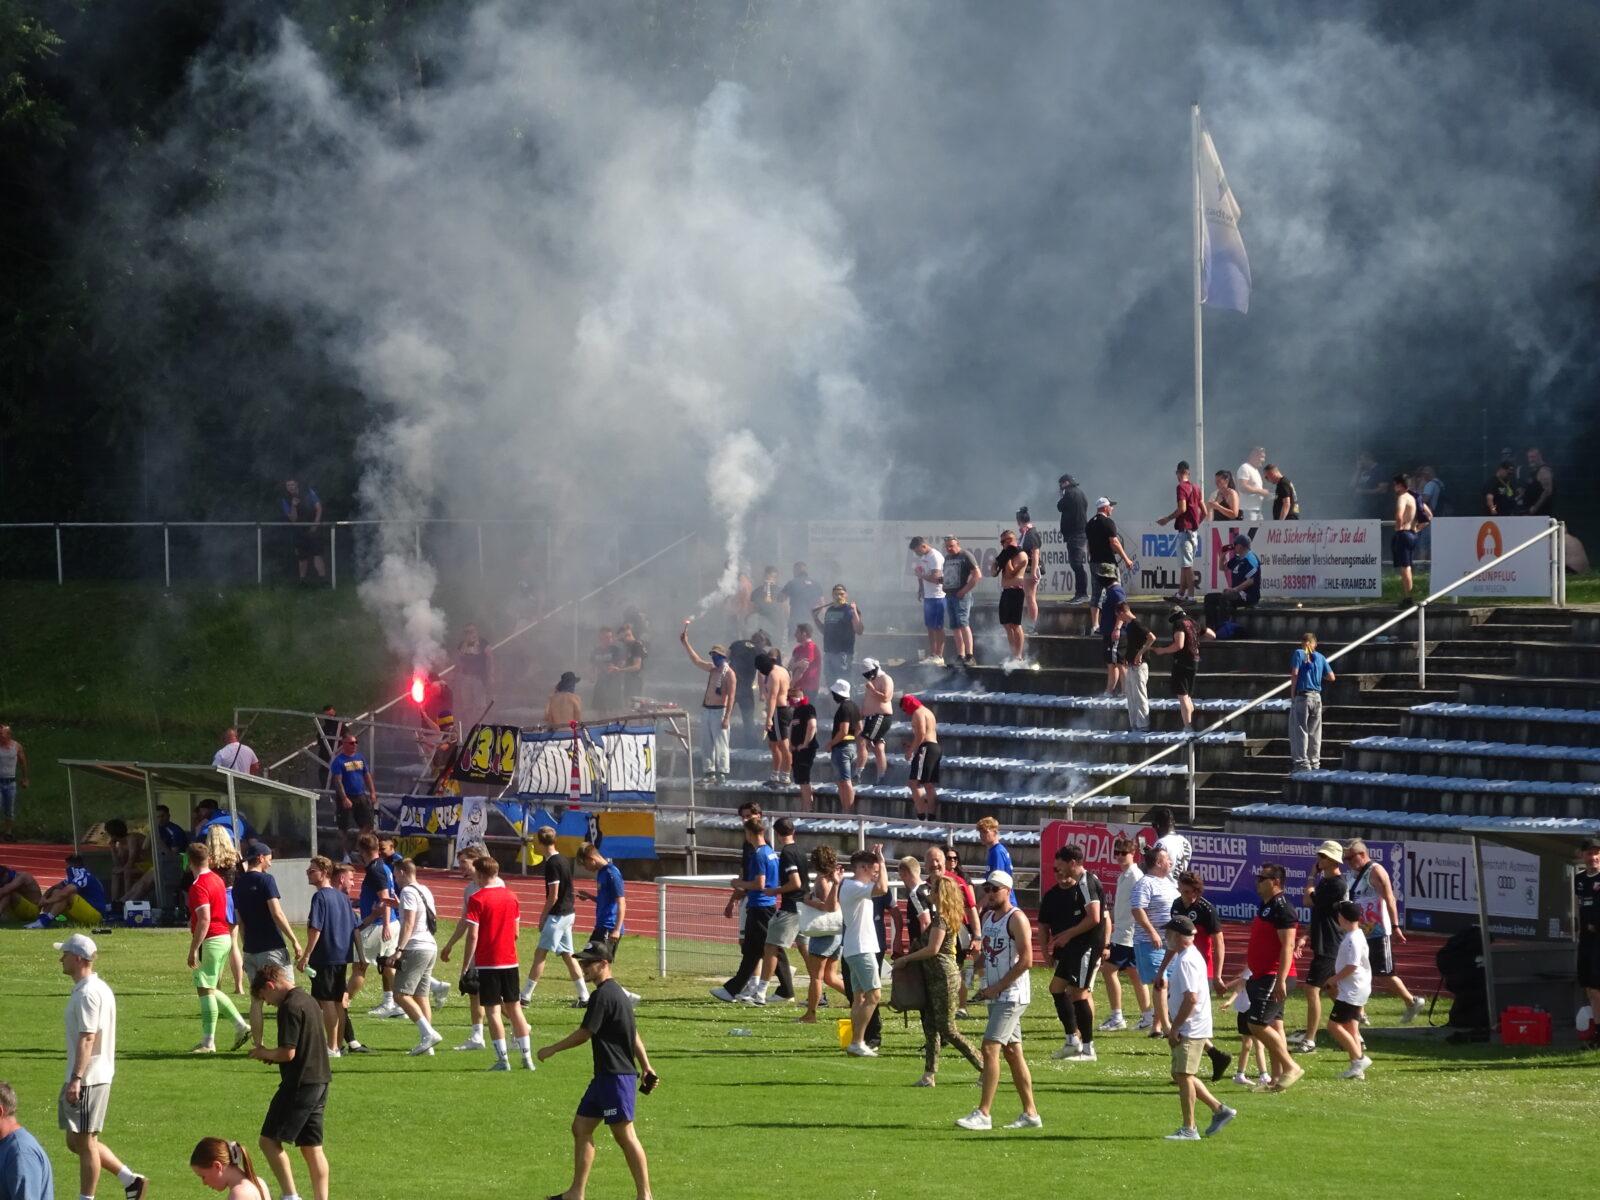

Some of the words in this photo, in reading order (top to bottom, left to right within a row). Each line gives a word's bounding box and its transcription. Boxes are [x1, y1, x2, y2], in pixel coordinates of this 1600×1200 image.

[1267, 528, 1281, 544] Mit
[1283, 526, 1323, 544] Sicherheit
[1322, 526, 1338, 549] für
[1339, 528, 1350, 544] Sie
[1352, 526, 1367, 544] da!
[1260, 555, 1270, 566] Die
[1272, 554, 1311, 566] Weißenfelser
[1313, 553, 1377, 568] Versicherungsmakler
[1141, 566, 1202, 589] MÜLLR
[1282, 574, 1316, 590] 3839870
[1187, 835, 1247, 856] IESECKER
[993, 937, 1005, 949] 15
